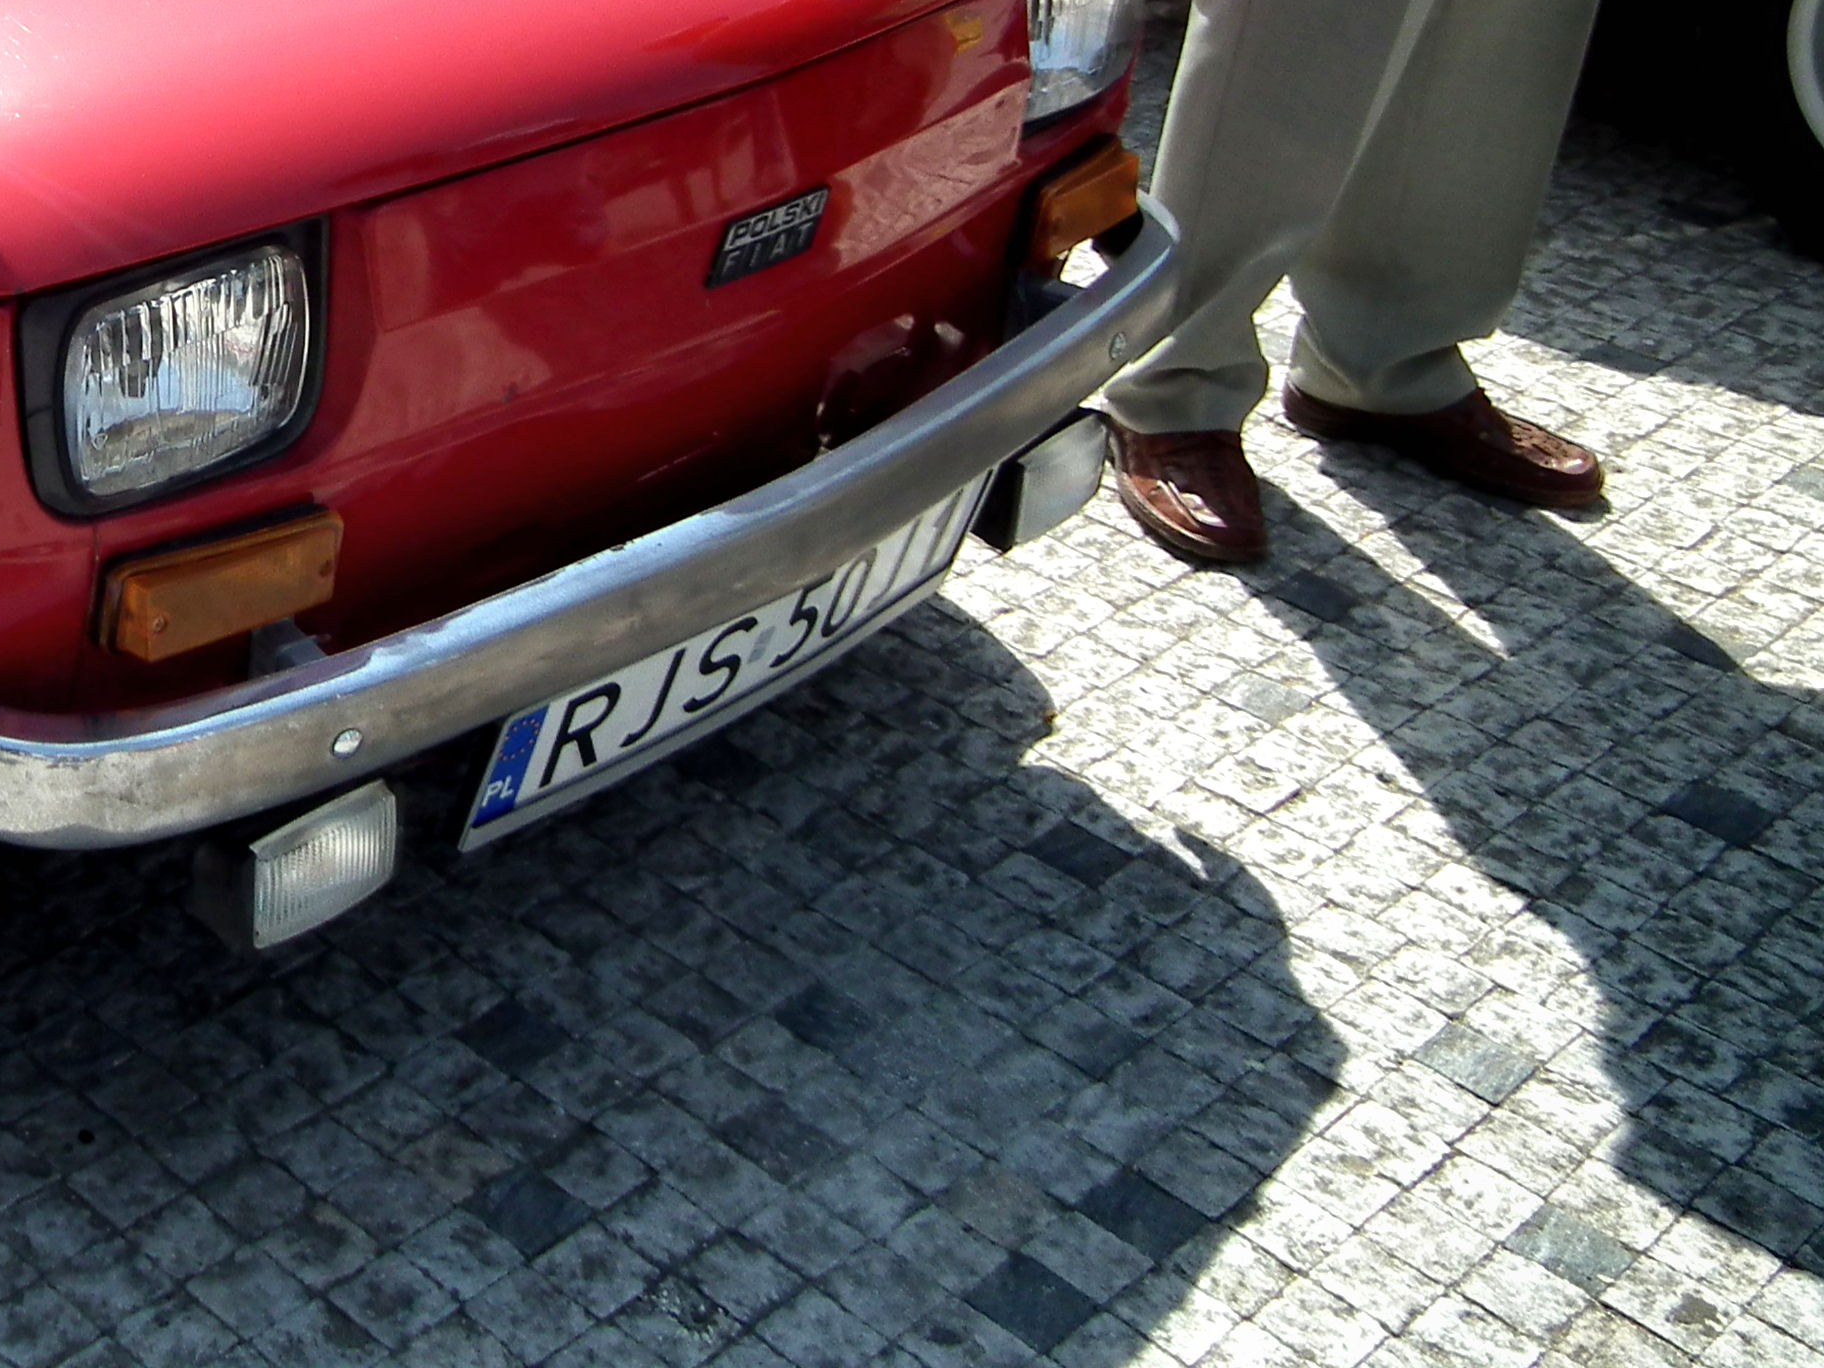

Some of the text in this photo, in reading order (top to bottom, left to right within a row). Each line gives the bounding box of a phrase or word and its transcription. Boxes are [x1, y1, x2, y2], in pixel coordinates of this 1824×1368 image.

[728, 190, 827, 247] POLSKI
[721, 221, 815, 277] FIAT
[538, 615, 759, 790] RJS
[481, 774, 515, 807] PL
